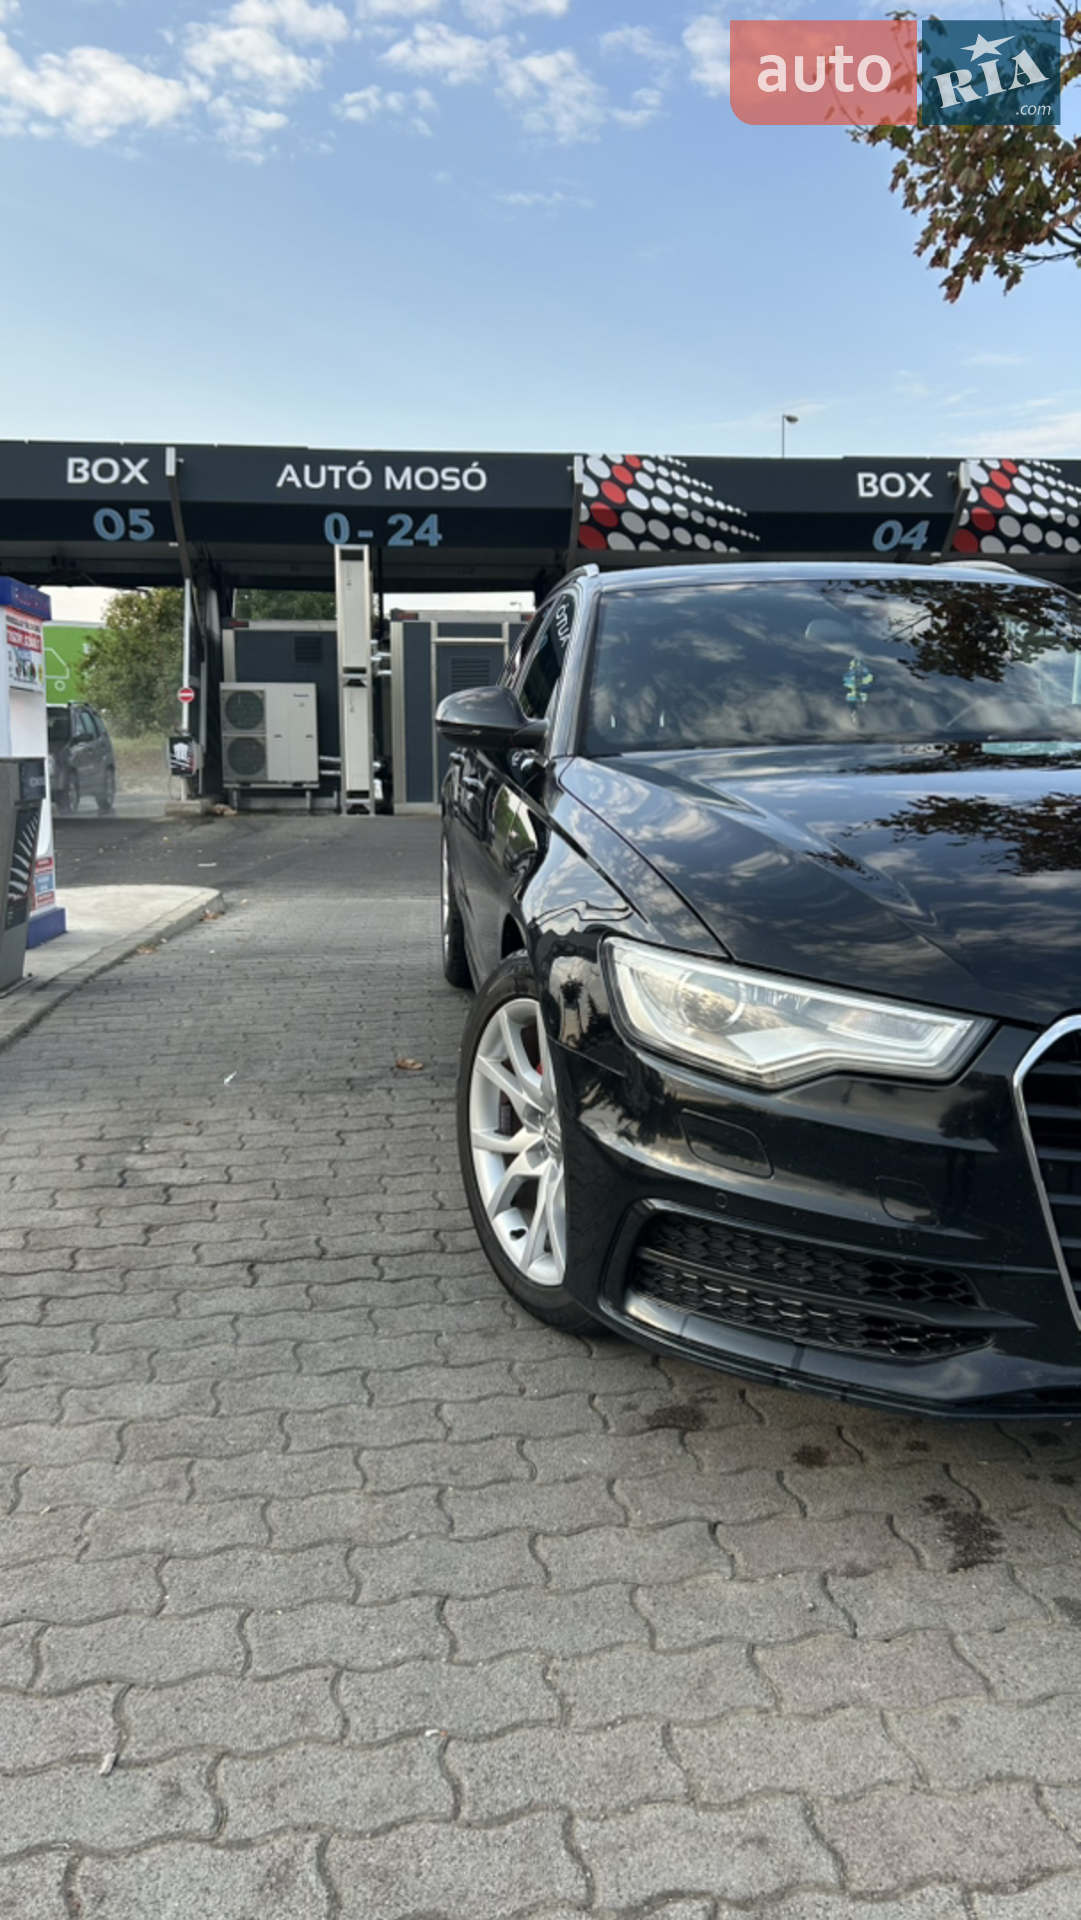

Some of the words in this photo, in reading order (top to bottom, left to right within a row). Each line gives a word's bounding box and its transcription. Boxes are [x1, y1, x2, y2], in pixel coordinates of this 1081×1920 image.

[66, 457, 150, 484] BOX
[276, 460, 373, 491] AUTÓ
[384, 461, 487, 492] MOSÓ
[857, 472, 934, 498] BOX
[93, 507, 155, 541] 05
[387, 513, 442, 547] 24
[872, 519, 930, 551] 04
